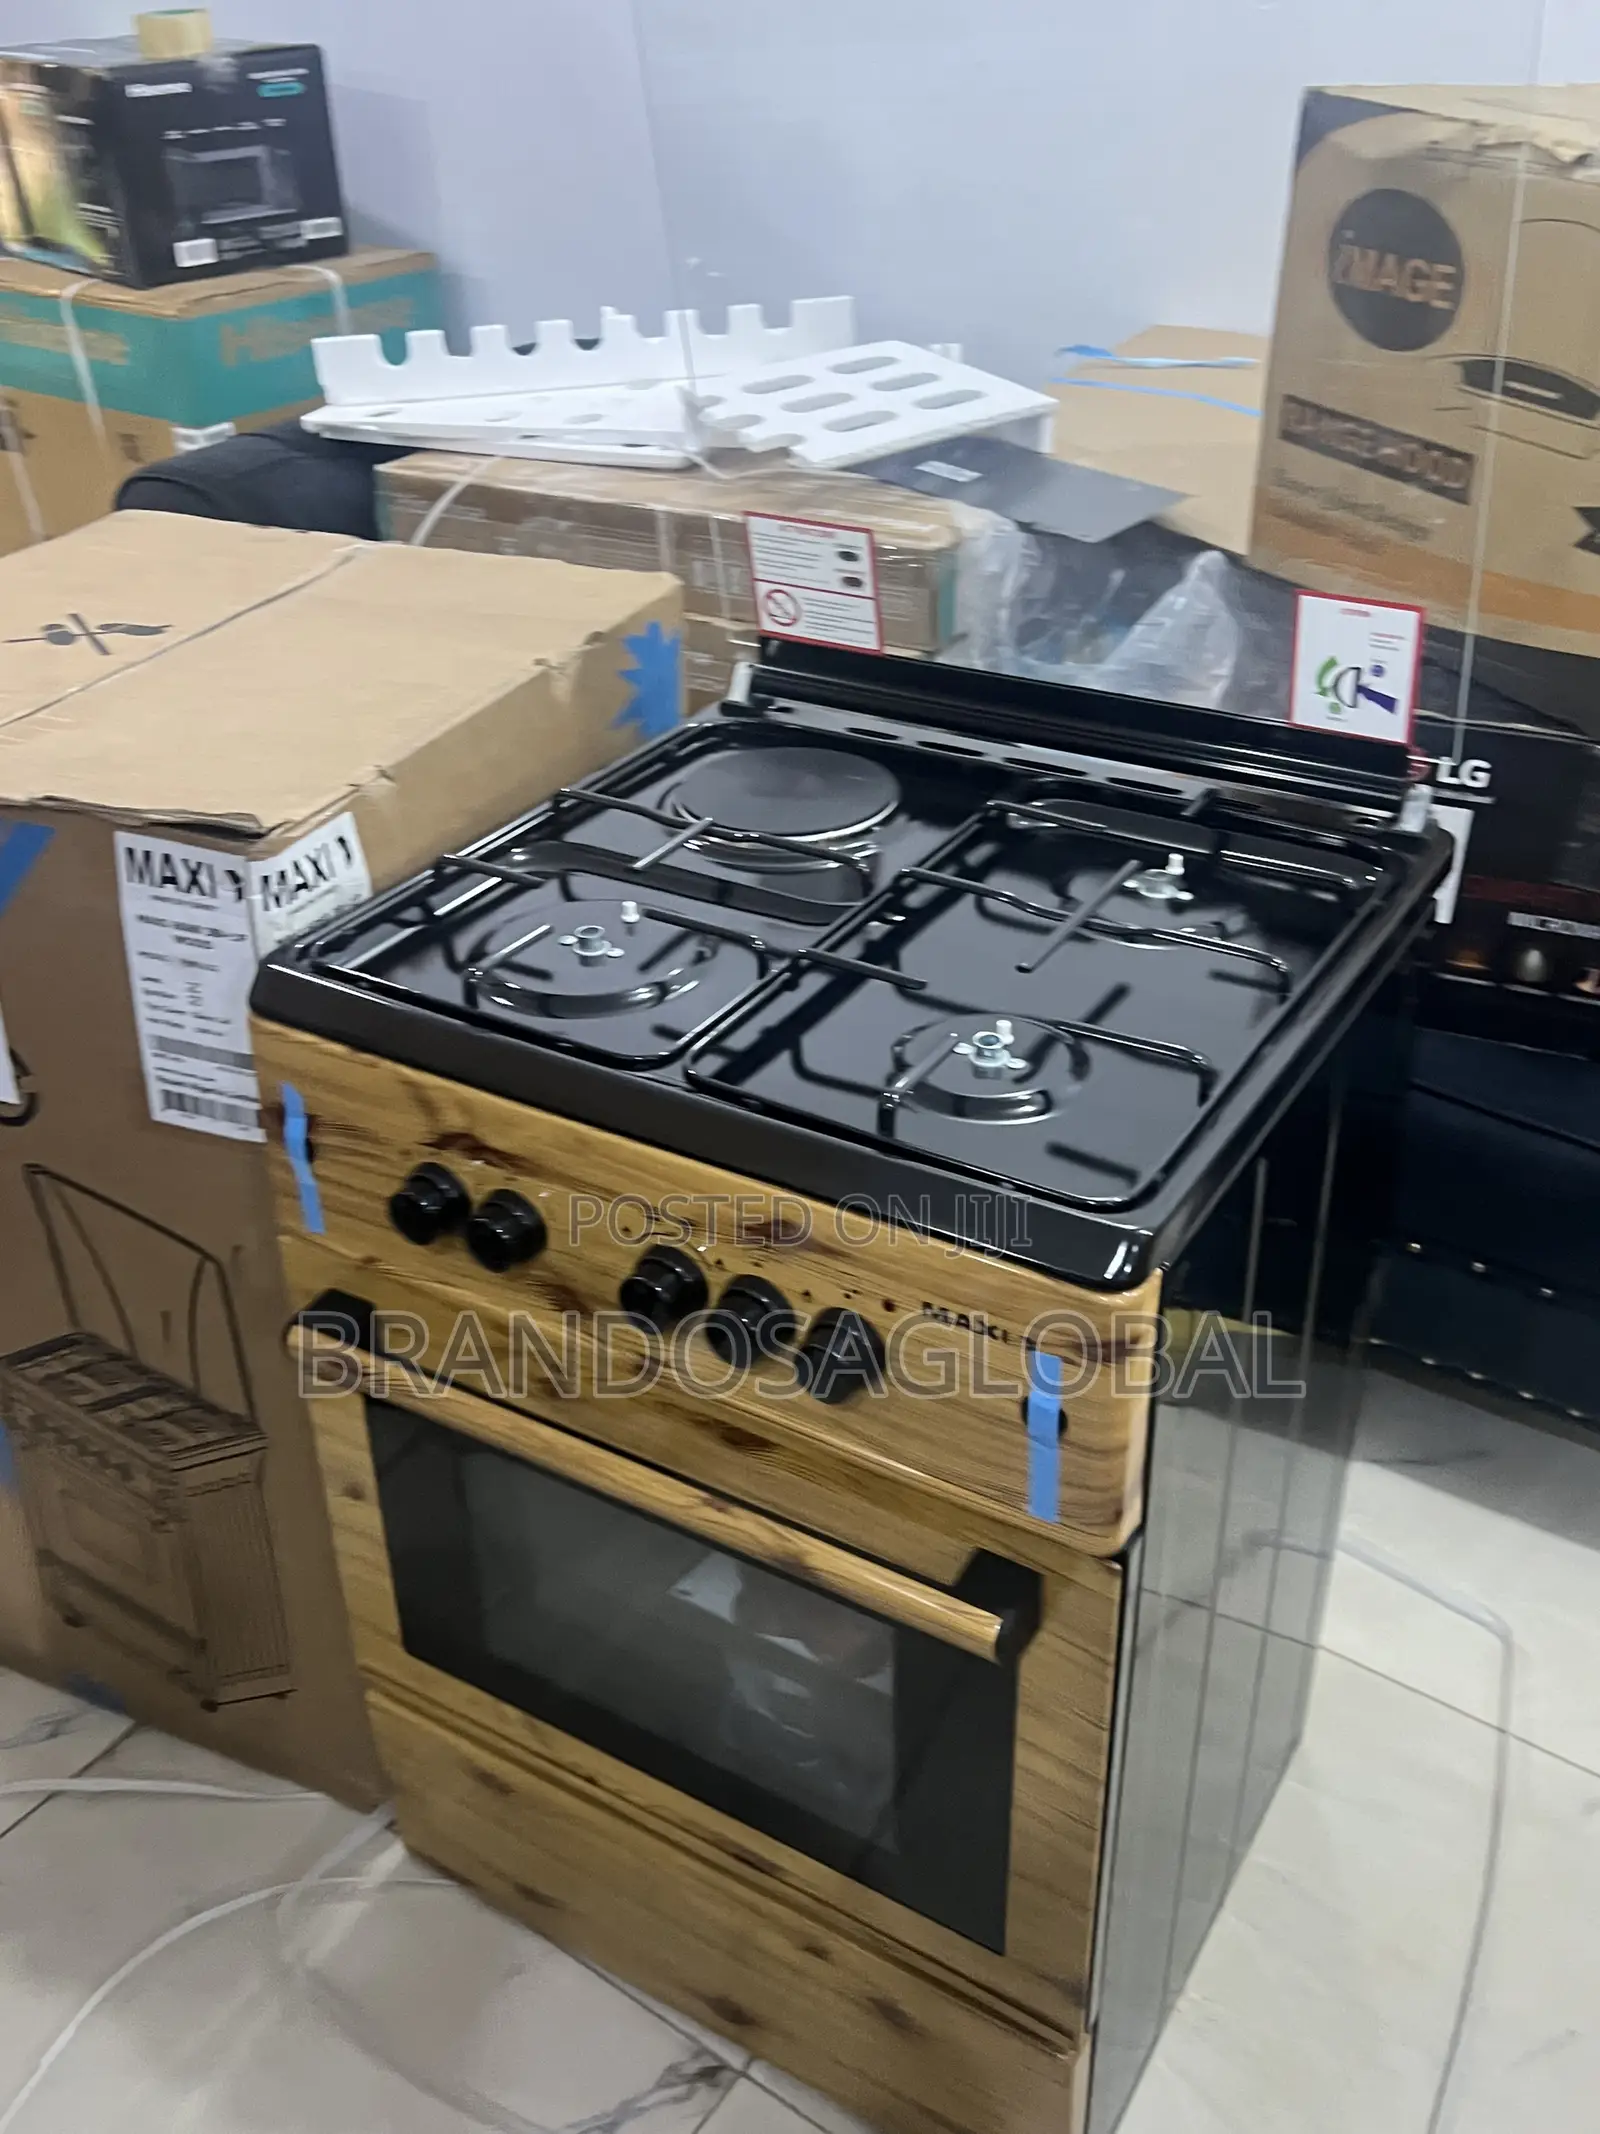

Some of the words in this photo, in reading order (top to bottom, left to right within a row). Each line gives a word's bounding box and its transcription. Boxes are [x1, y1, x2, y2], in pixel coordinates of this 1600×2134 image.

[1436, 756, 1492, 788] LG
[125, 847, 218, 899] MAXI
[260, 842, 337, 912] MAXI
